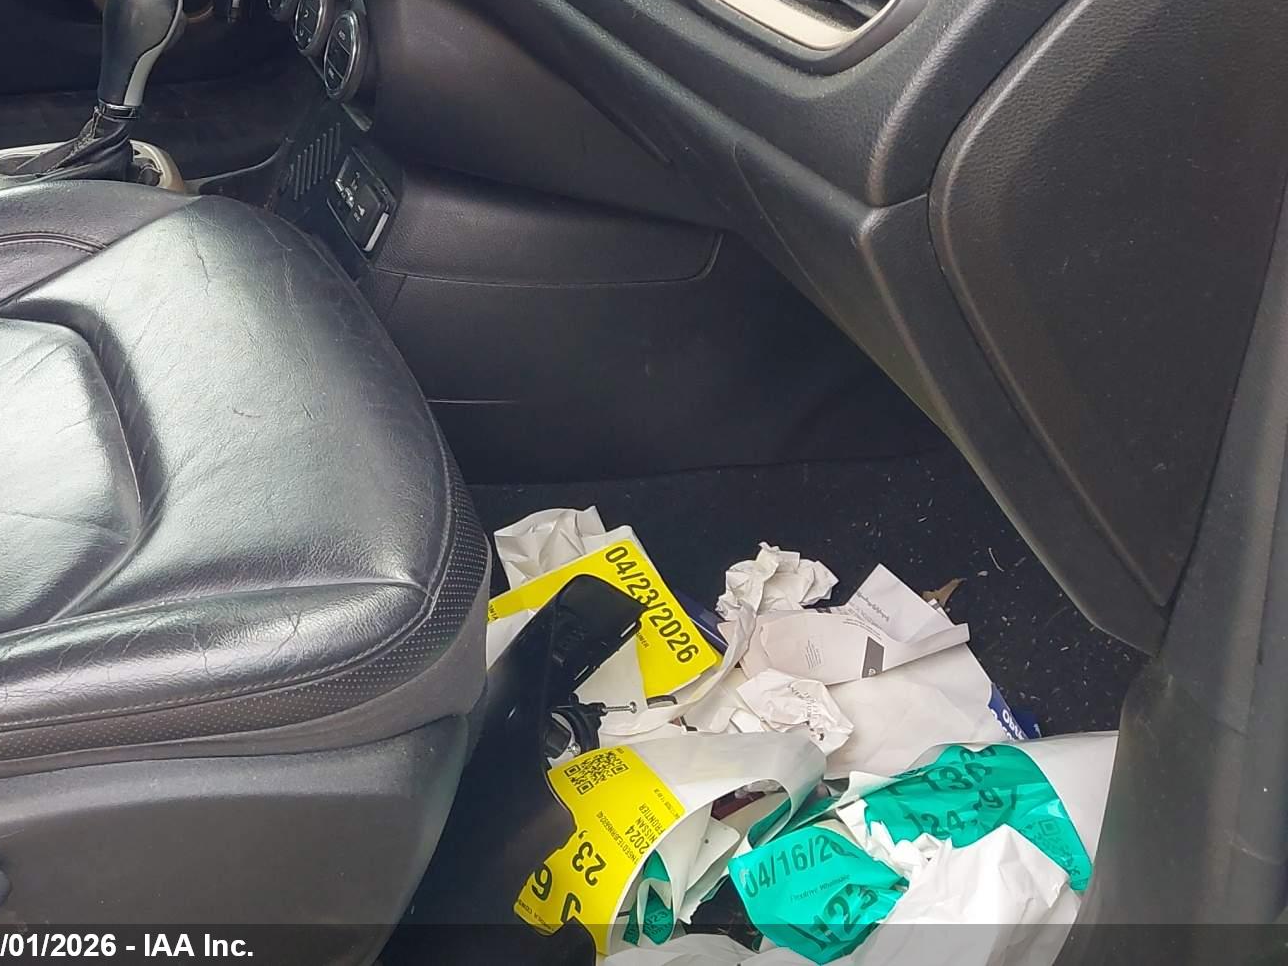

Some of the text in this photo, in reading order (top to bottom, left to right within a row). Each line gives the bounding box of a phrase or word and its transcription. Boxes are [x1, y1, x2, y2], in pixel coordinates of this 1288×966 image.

[604, 546, 699, 666] 04/23/2026
[634, 817, 656, 844] NISSAN
[639, 803, 665, 836] FRONTIER
[625, 825, 649, 855] 2024
